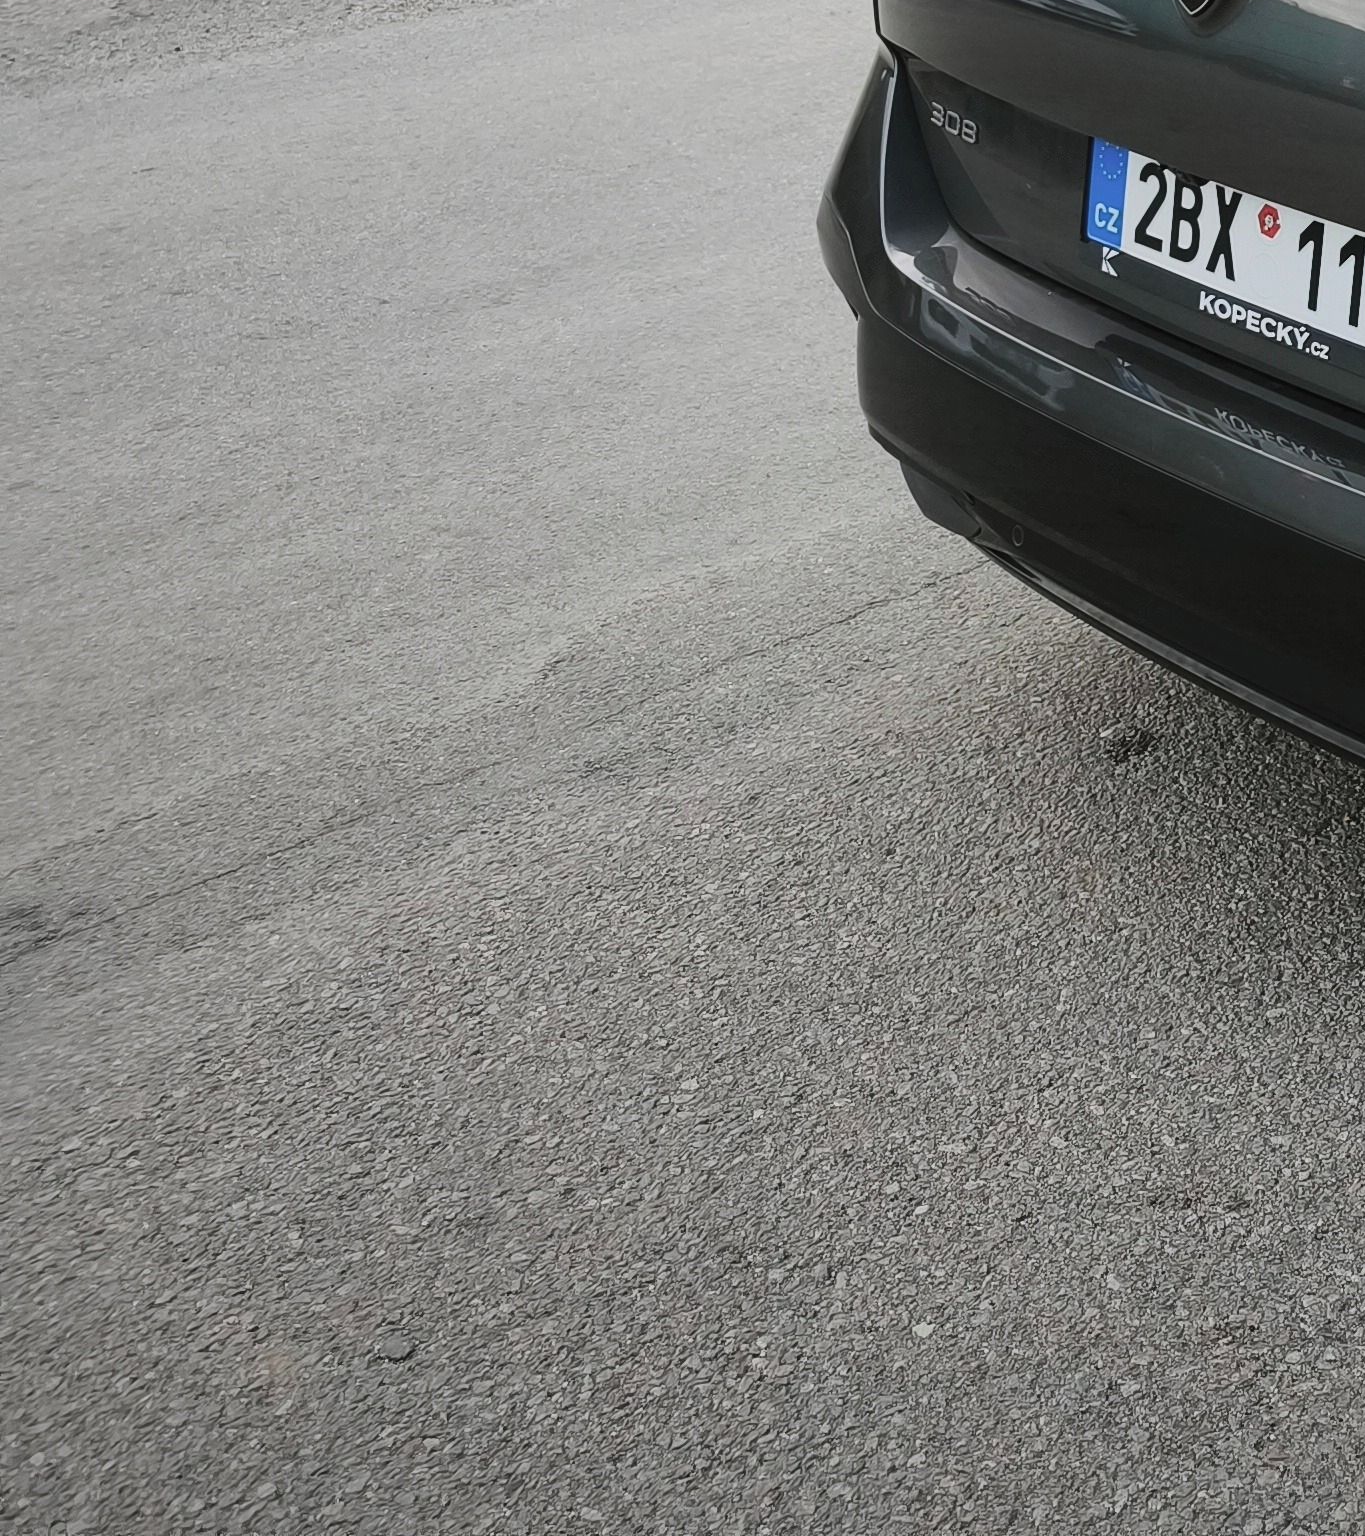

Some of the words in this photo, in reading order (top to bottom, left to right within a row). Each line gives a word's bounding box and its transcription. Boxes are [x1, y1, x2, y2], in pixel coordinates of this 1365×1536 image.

[930, 101, 977, 144] 308
[1094, 203, 1120, 234] CZ
[1134, 162, 1243, 282] 2BX
